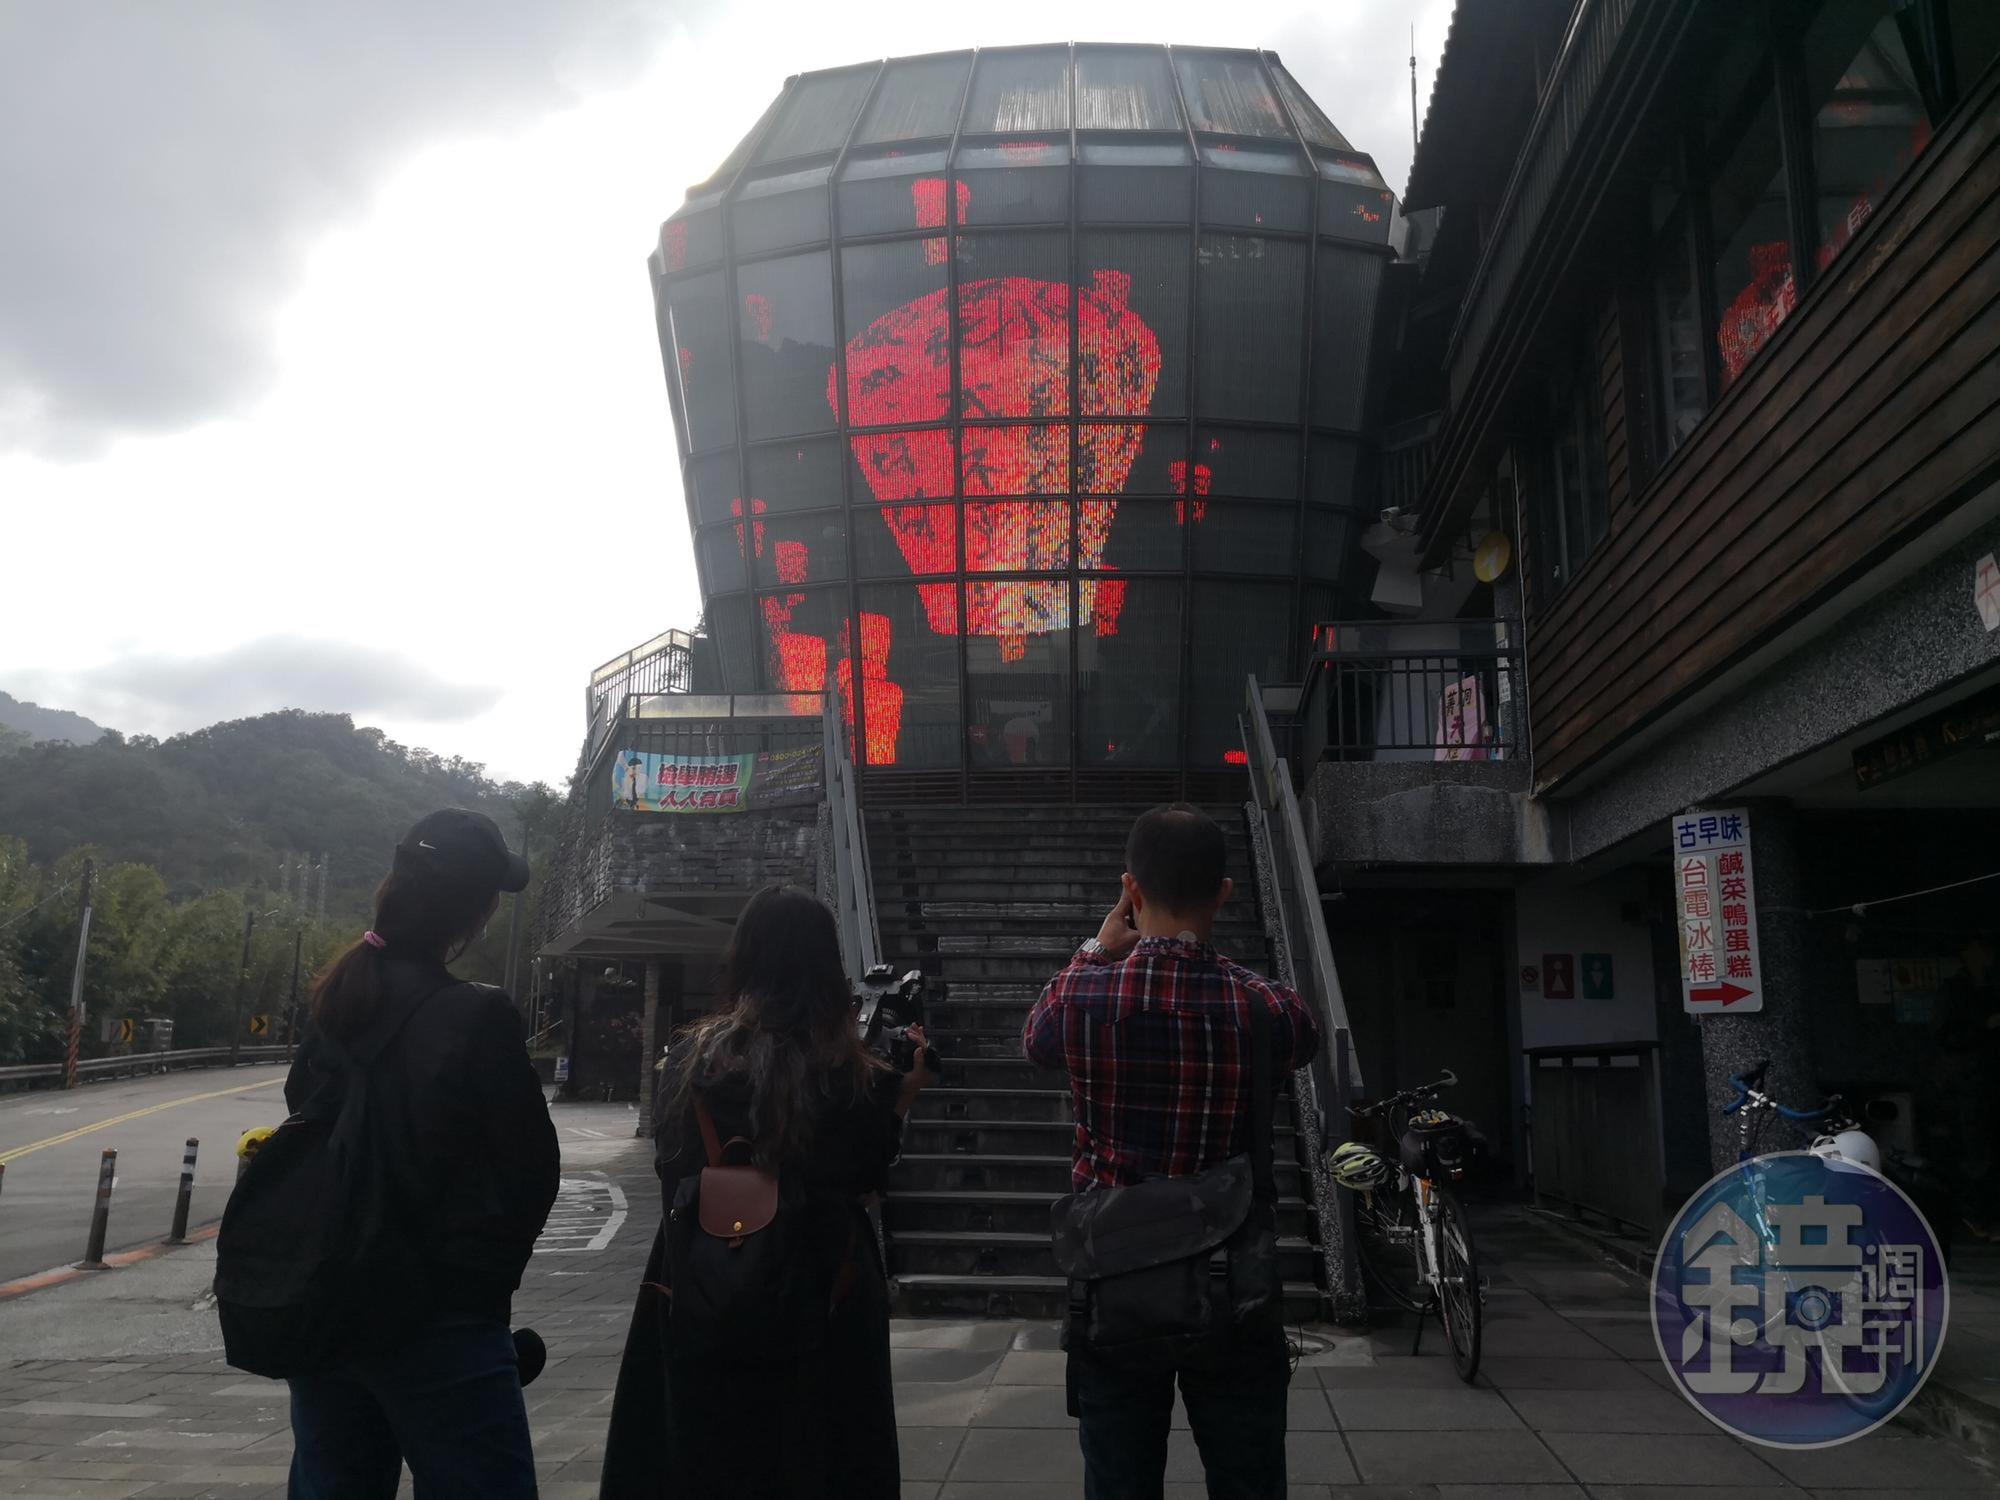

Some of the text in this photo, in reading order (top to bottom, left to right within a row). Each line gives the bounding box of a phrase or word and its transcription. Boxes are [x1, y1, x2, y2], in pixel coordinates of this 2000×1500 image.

[656, 763, 740, 787] 檢舉賄選
[659, 786, 741, 810] 人人有責
[1677, 814, 1743, 848] 古早味
[1682, 858, 1715, 981] 台電冰棒
